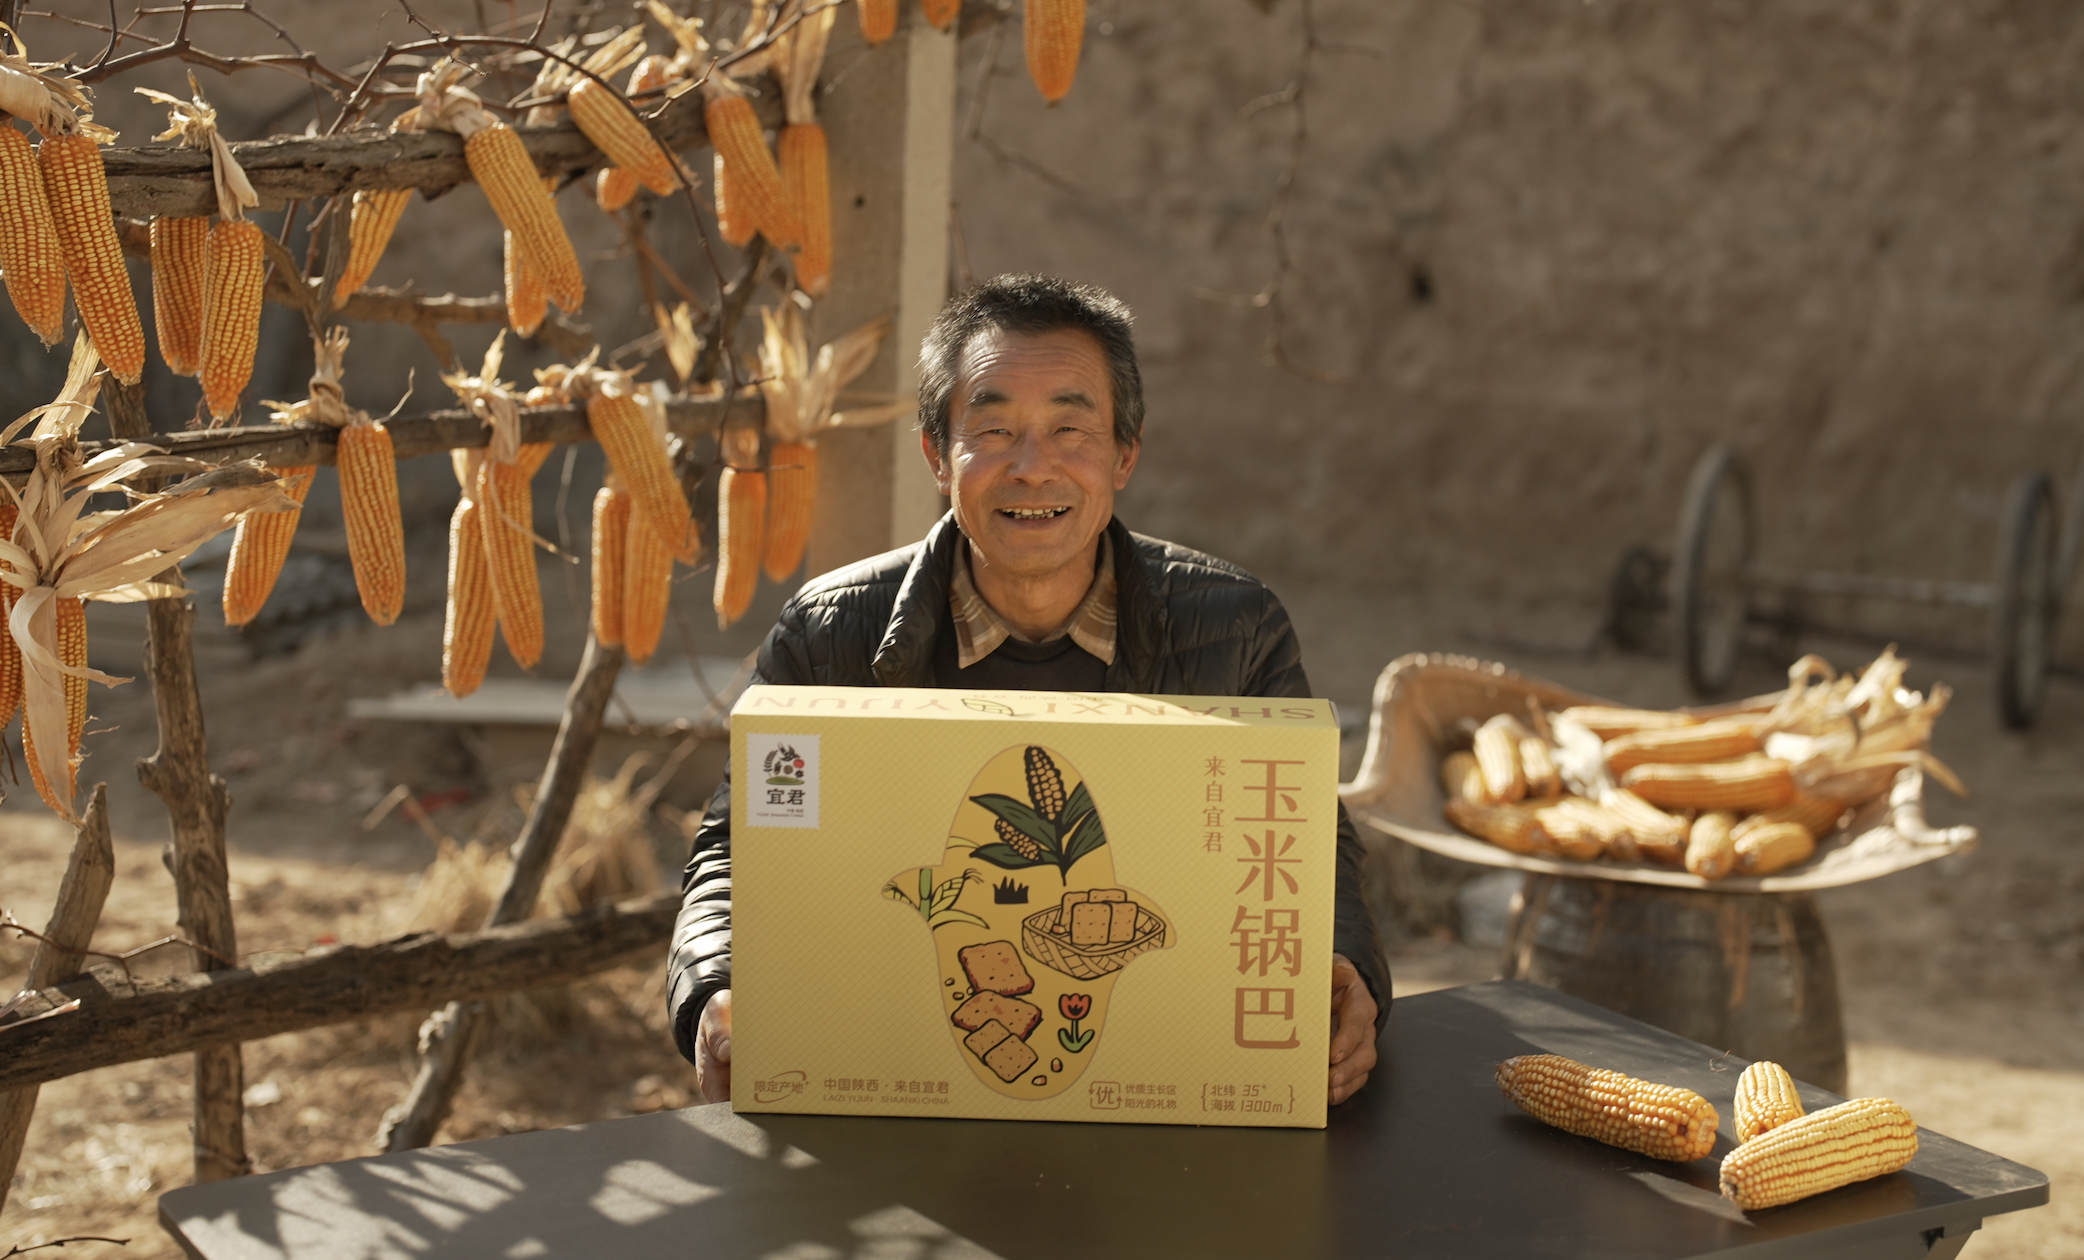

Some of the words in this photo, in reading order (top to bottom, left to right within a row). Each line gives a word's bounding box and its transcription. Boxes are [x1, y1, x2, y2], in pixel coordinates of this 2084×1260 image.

[752, 696, 951, 711] YIJUN
[1046, 702, 1316, 720] SHANXI
[766, 787, 806, 806] 宜君
[1201, 755, 1227, 853] 来自宜君
[1229, 758, 1308, 1050] 玉米锅巴
[754, 1079, 804, 1094] 限定产地
[1125, 1083, 1177, 1096] 优质生长区
[1210, 1084, 1236, 1097] 北纬
[1242, 1084, 1267, 1097] 35°
[823, 1094, 845, 1103] LAIZI
[847, 1094, 874, 1104] YIJUN
[1096, 1086, 1115, 1105] 优
[1124, 1098, 1177, 1110] 阳光的礼物
[1210, 1099, 1236, 1112] 海拔
[1240, 1099, 1283, 1113] 1300m
